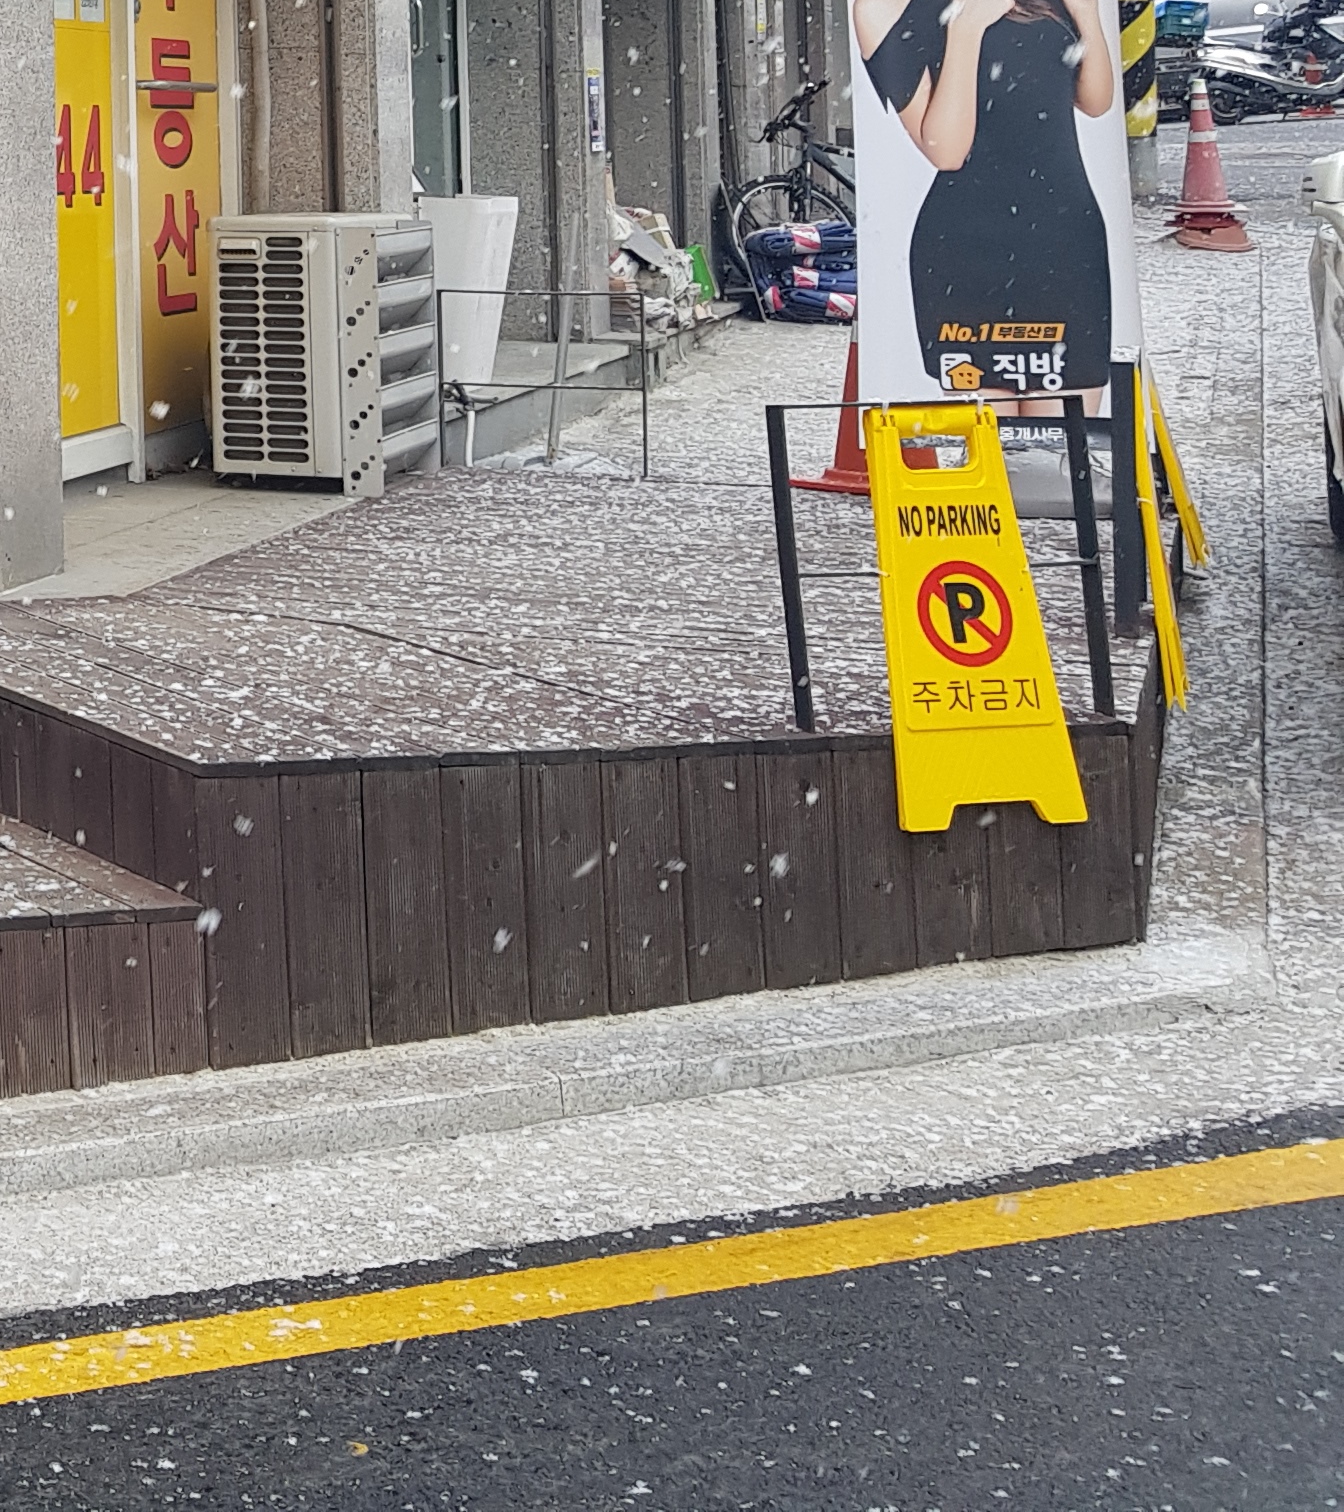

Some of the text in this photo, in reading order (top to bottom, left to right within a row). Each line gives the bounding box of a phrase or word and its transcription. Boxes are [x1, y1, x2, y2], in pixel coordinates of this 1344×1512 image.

[938, 322, 991, 343] No.1
[993, 352, 1065, 392] 직방
[999, 426, 1067, 442] 중개사무
[897, 503, 1002, 538] NO PARKING
[911, 676, 1041, 714] 주차금지
